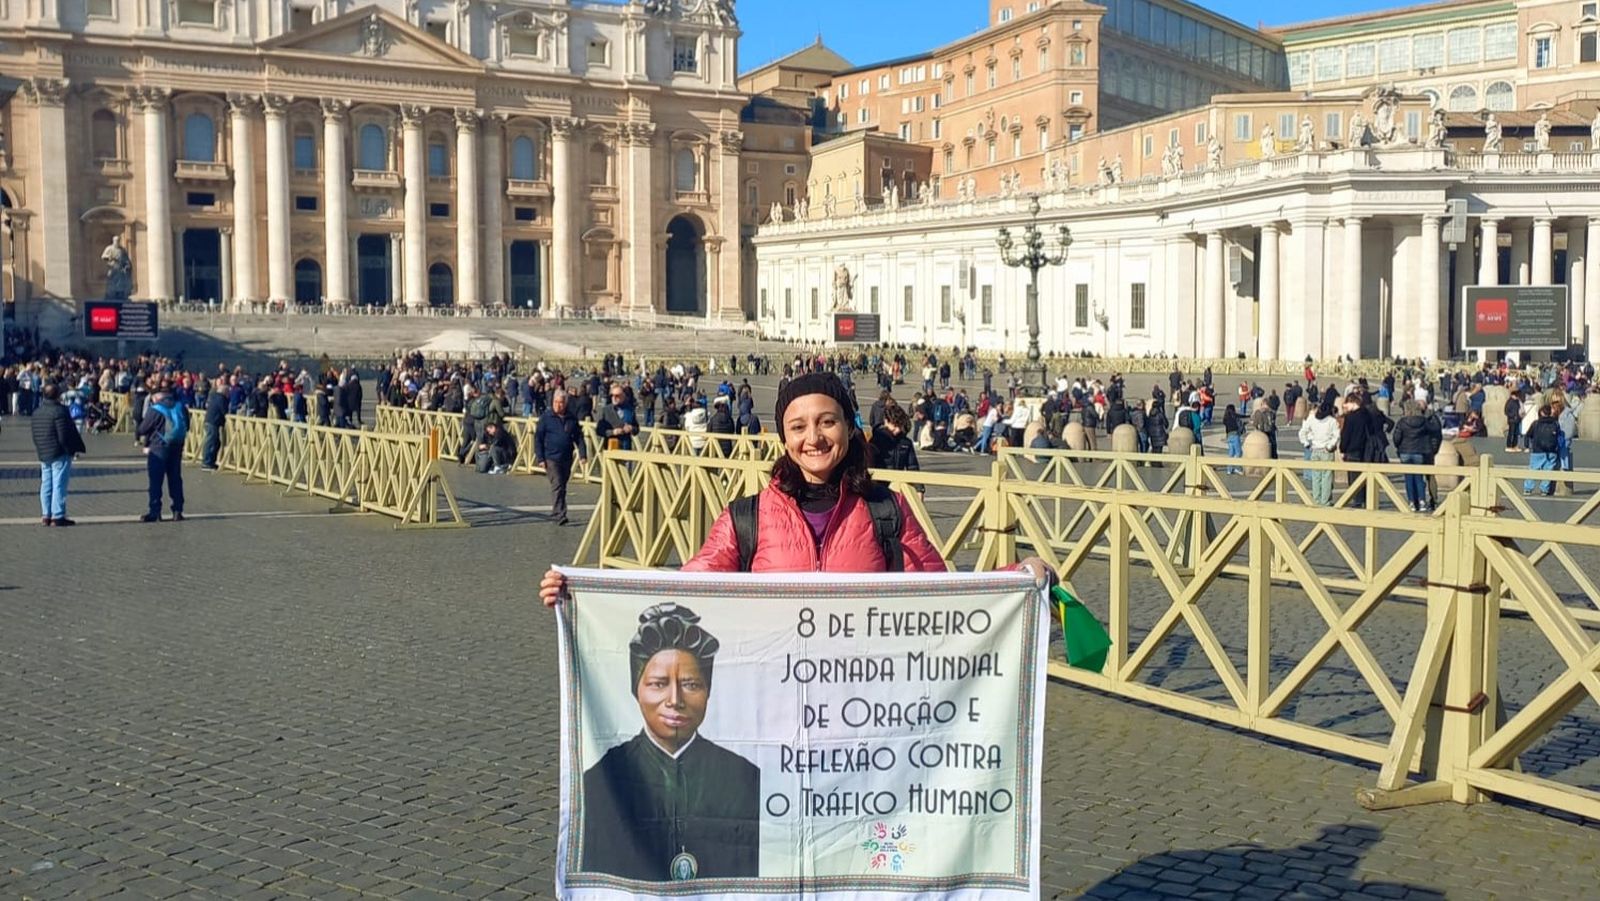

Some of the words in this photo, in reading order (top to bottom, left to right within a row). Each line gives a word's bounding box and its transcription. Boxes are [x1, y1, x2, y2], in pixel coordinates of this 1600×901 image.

[797, 607, 816, 638] 8
[828, 613, 856, 638] DE
[867, 607, 992, 637] FEVEREIRO
[781, 653, 895, 684] JORNADA
[906, 651, 1003, 681] MUNDIAL
[803, 703, 830, 729] DE
[841, 696, 956, 732] ORAÇÃO
[968, 697, 980, 722] E
[780, 741, 896, 773] REFLEXÃO
[908, 740, 1002, 769] CONTRA
[766, 793, 790, 817] O
[801, 786, 897, 817] TRÁFICO
[908, 783, 1013, 815] HUMANO
